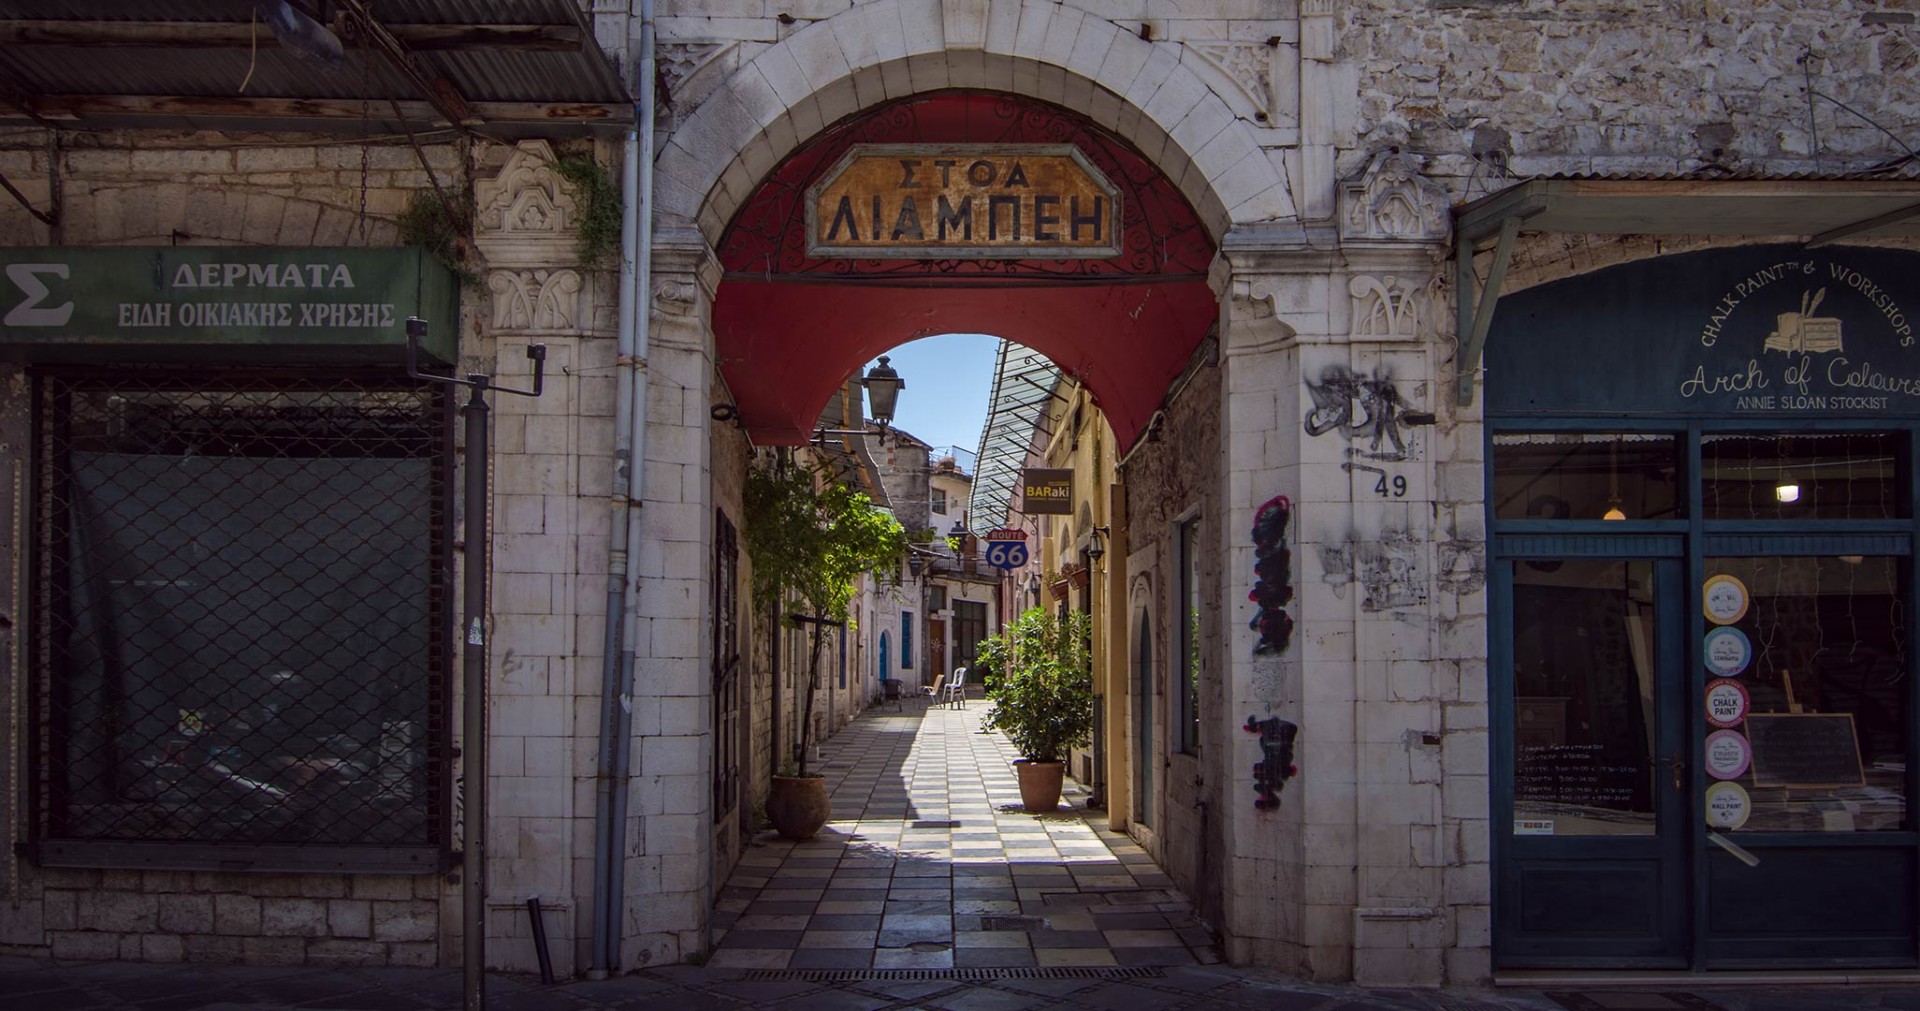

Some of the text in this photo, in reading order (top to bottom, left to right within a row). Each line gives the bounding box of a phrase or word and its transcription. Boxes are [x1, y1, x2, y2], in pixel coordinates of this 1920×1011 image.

[899, 160, 1030, 189] ΣΤΟΑ
[827, 194, 1102, 241] ΛΙΑΜΠΕΗ
[172, 263, 355, 288] ΔΕΡΜΑΤΑ
[3, 263, 74, 327] Σ
[1701, 292, 1740, 348] CHALK
[1802, 260, 1817, 275] &
[1828, 262, 1916, 348] WORKSHOPS
[118, 302, 396, 328] ΕΙΔΗ ΟΙΚΙΑΚΗΣ ΧΡΗΣΗΣ
[1680, 355, 1920, 398] Arch of Colours
[1736, 396, 1889, 410] ANNIE SLOAN STOCKIST
[1026, 486, 1070, 498] BARaki
[1374, 474, 1408, 498] 49
[991, 531, 1024, 540] ROUTE
[990, 544, 1024, 566] 66
[1713, 698, 1738, 707] CHALK
[1715, 707, 1737, 716] PAINT
